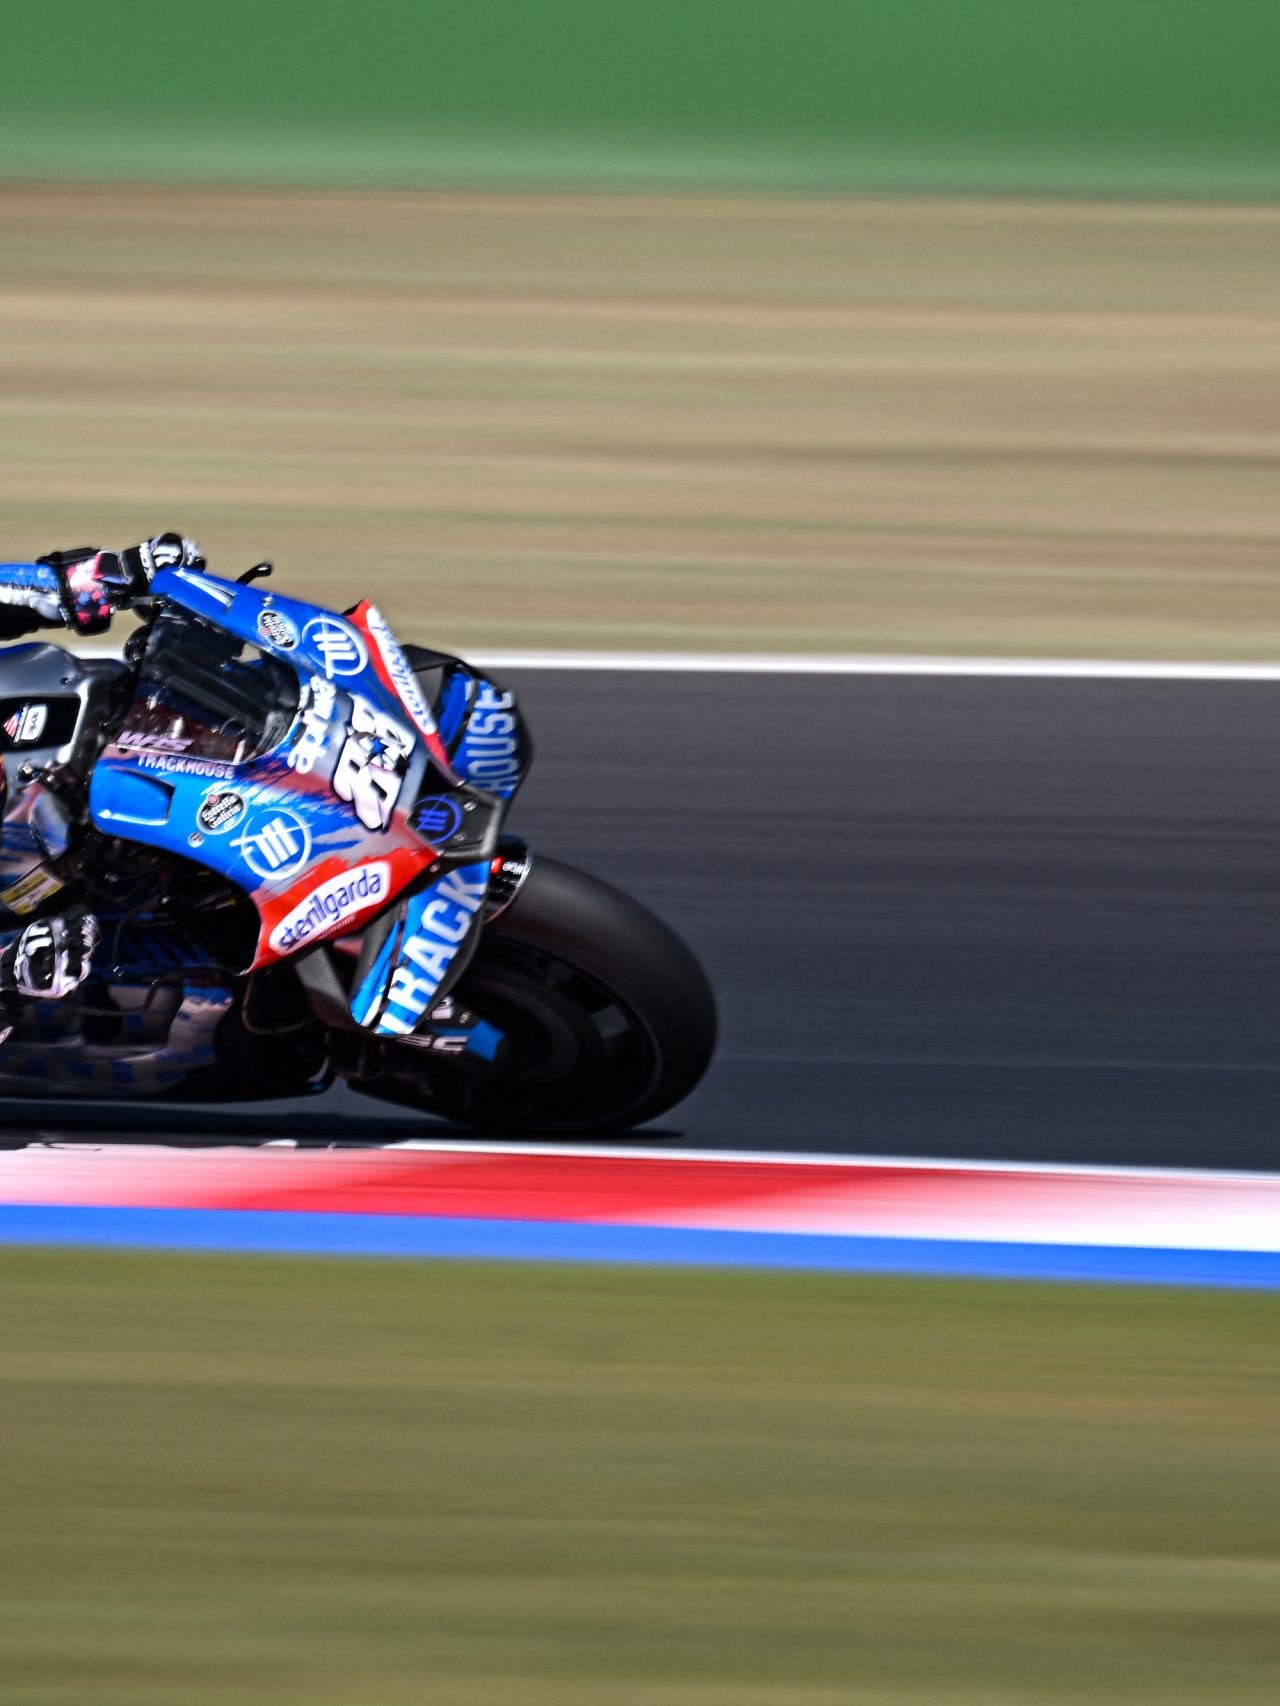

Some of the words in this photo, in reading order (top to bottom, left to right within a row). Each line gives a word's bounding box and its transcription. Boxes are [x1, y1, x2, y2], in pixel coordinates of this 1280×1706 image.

[137, 753, 235, 780] TRACKHOUSE
[202, 795, 238, 821] Estrella
[209, 804, 243, 829] Galicia
[280, 869, 382, 951] sterilgarda
